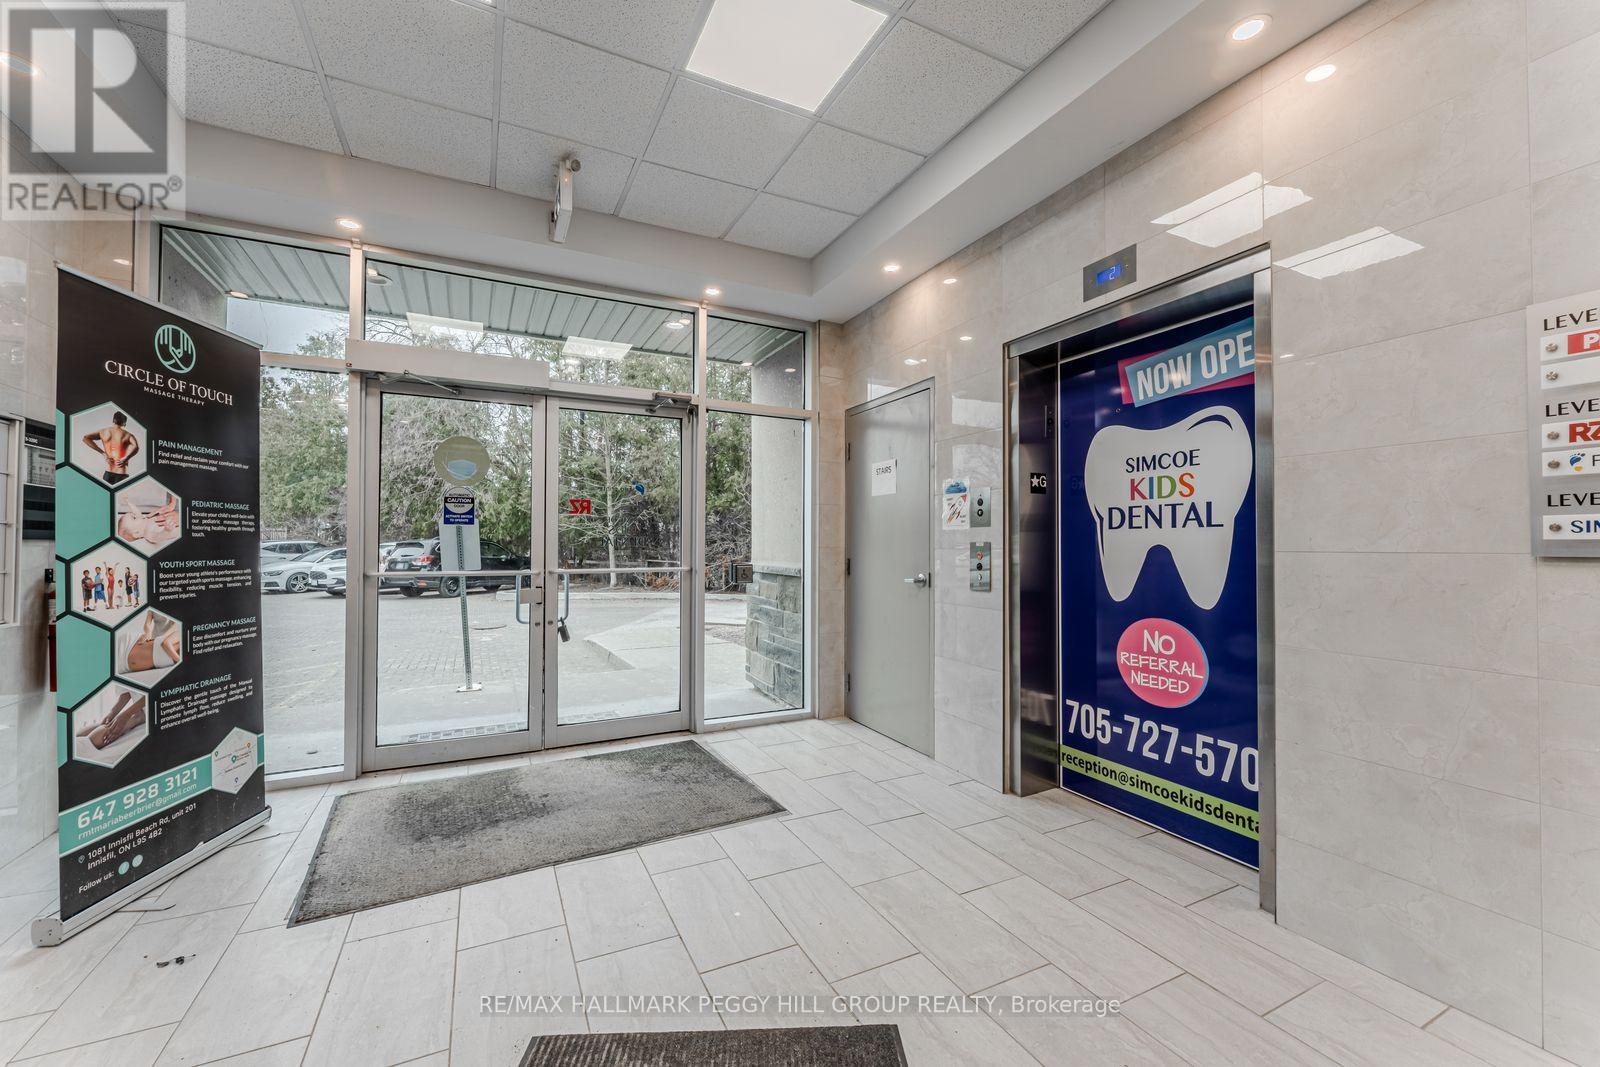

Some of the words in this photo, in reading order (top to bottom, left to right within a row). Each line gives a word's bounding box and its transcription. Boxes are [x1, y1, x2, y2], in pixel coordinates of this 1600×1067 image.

[1109, 266, 1115, 280] 2
[105, 360, 164, 387] CIRCLE
[168, 378, 187, 392] OF
[189, 384, 233, 406] TOUCH
[1136, 353, 1192, 400] NOW
[144, 387, 175, 399] MASSAGE
[178, 395, 205, 406] THERAPY
[159, 440, 176, 448] PAIN
[177, 443, 222, 456] MANAGEMENT
[876, 466, 892, 475] STAIRS
[1125, 448, 1200, 473] SIMCOE
[1130, 472, 1195, 501] KIDS
[192, 500, 223, 508] PEDIATRIC
[1108, 501, 1224, 530] DENTAL
[193, 620, 230, 632] PREGNANCY
[231, 617, 256, 625] MASSAGE
[1143, 629, 1176, 656] NO
[1120, 651, 1204, 679] REFERRAL
[160, 682, 199, 697] LYMPHATIC
[200, 674, 231, 687] DRAINAGE
[1130, 669, 1190, 694] NEEDED
[161, 699, 181, 708] Discover
[194, 691, 207, 699] gentle
[161, 705, 184, 715] Lymphatic
[187, 698, 207, 707] Drainage
[161, 714, 181, 723] promote
[161, 720, 180, 730] enhance
[1066, 699, 1259, 792] 705-727-570
[77, 800, 116, 828] 647
[123, 783, 158, 809] 928
[165, 767, 197, 792] 3121
[88, 845, 105, 859] 1081
[109, 833, 134, 850] Innisfil
[136, 823, 157, 836] Beach
[172, 809, 183, 819] unit
[185, 803, 196, 813] 201
[88, 851, 116, 870] Innisfil,
[119, 844, 130, 854] ON
[133, 836, 147, 847] L9S
[79, 877, 102, 893] Follow
[104, 871, 114, 880] us:
